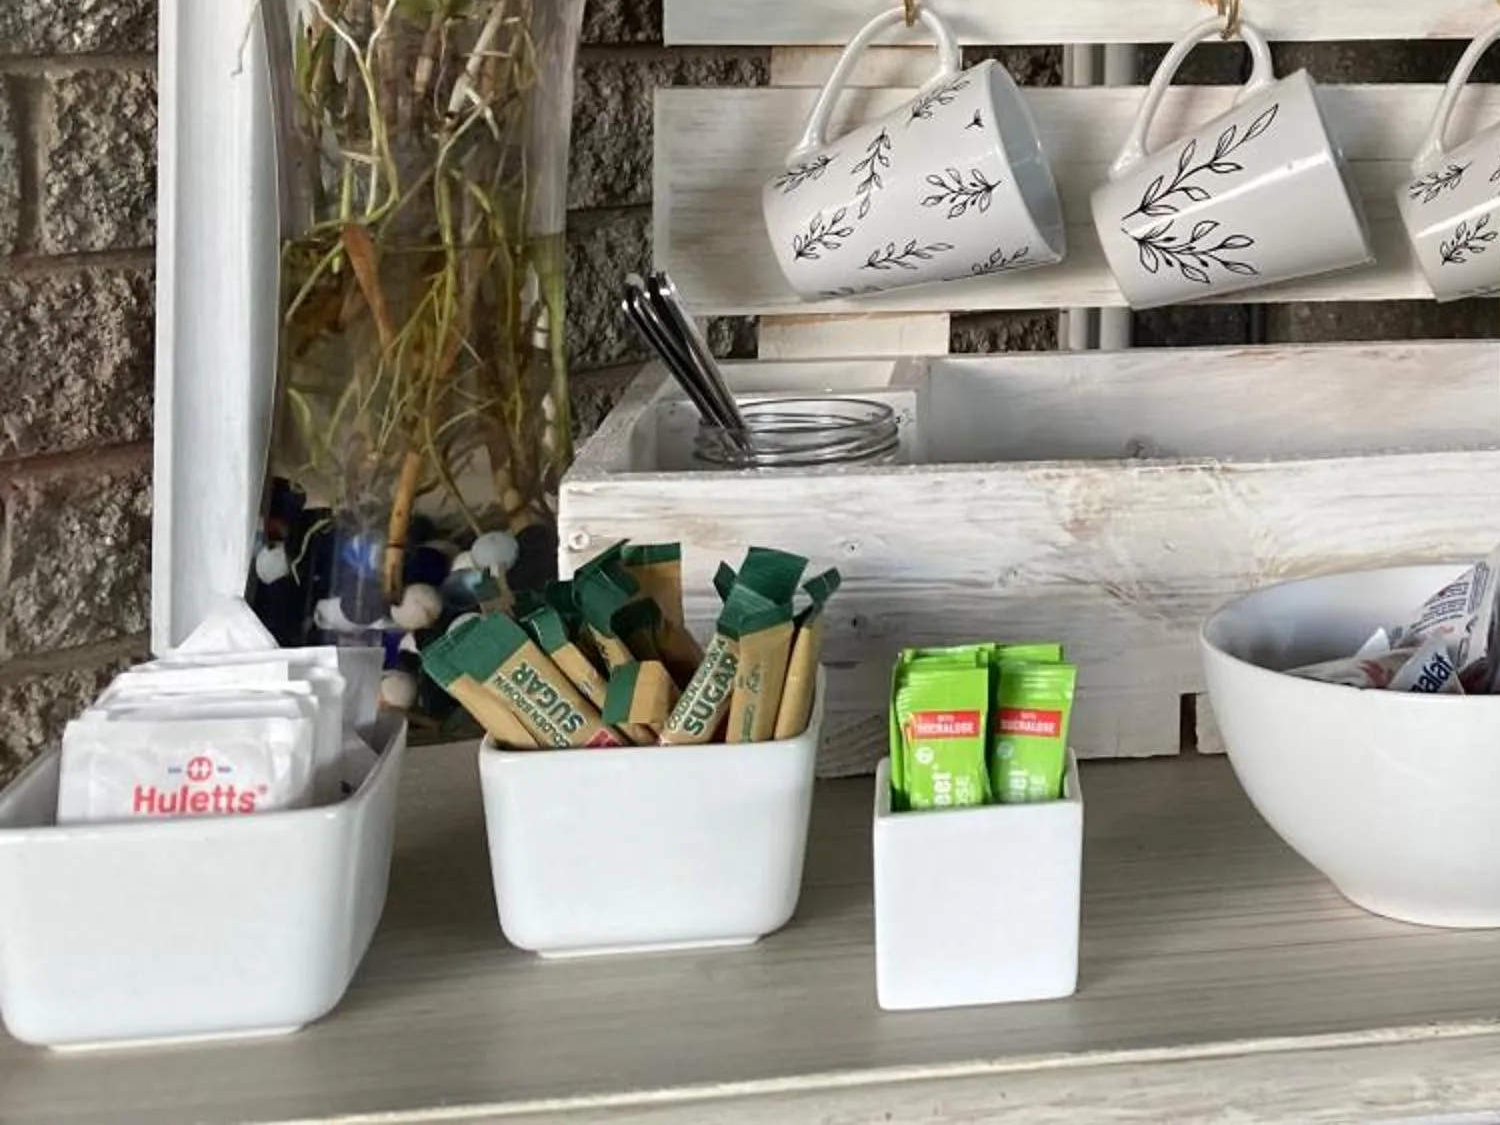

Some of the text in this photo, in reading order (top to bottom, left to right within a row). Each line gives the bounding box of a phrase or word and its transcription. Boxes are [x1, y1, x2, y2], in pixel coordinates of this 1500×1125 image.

[511, 661, 585, 734] SUGAR
[683, 653, 739, 736] SUGAR
[133, 784, 258, 816] Huletts
